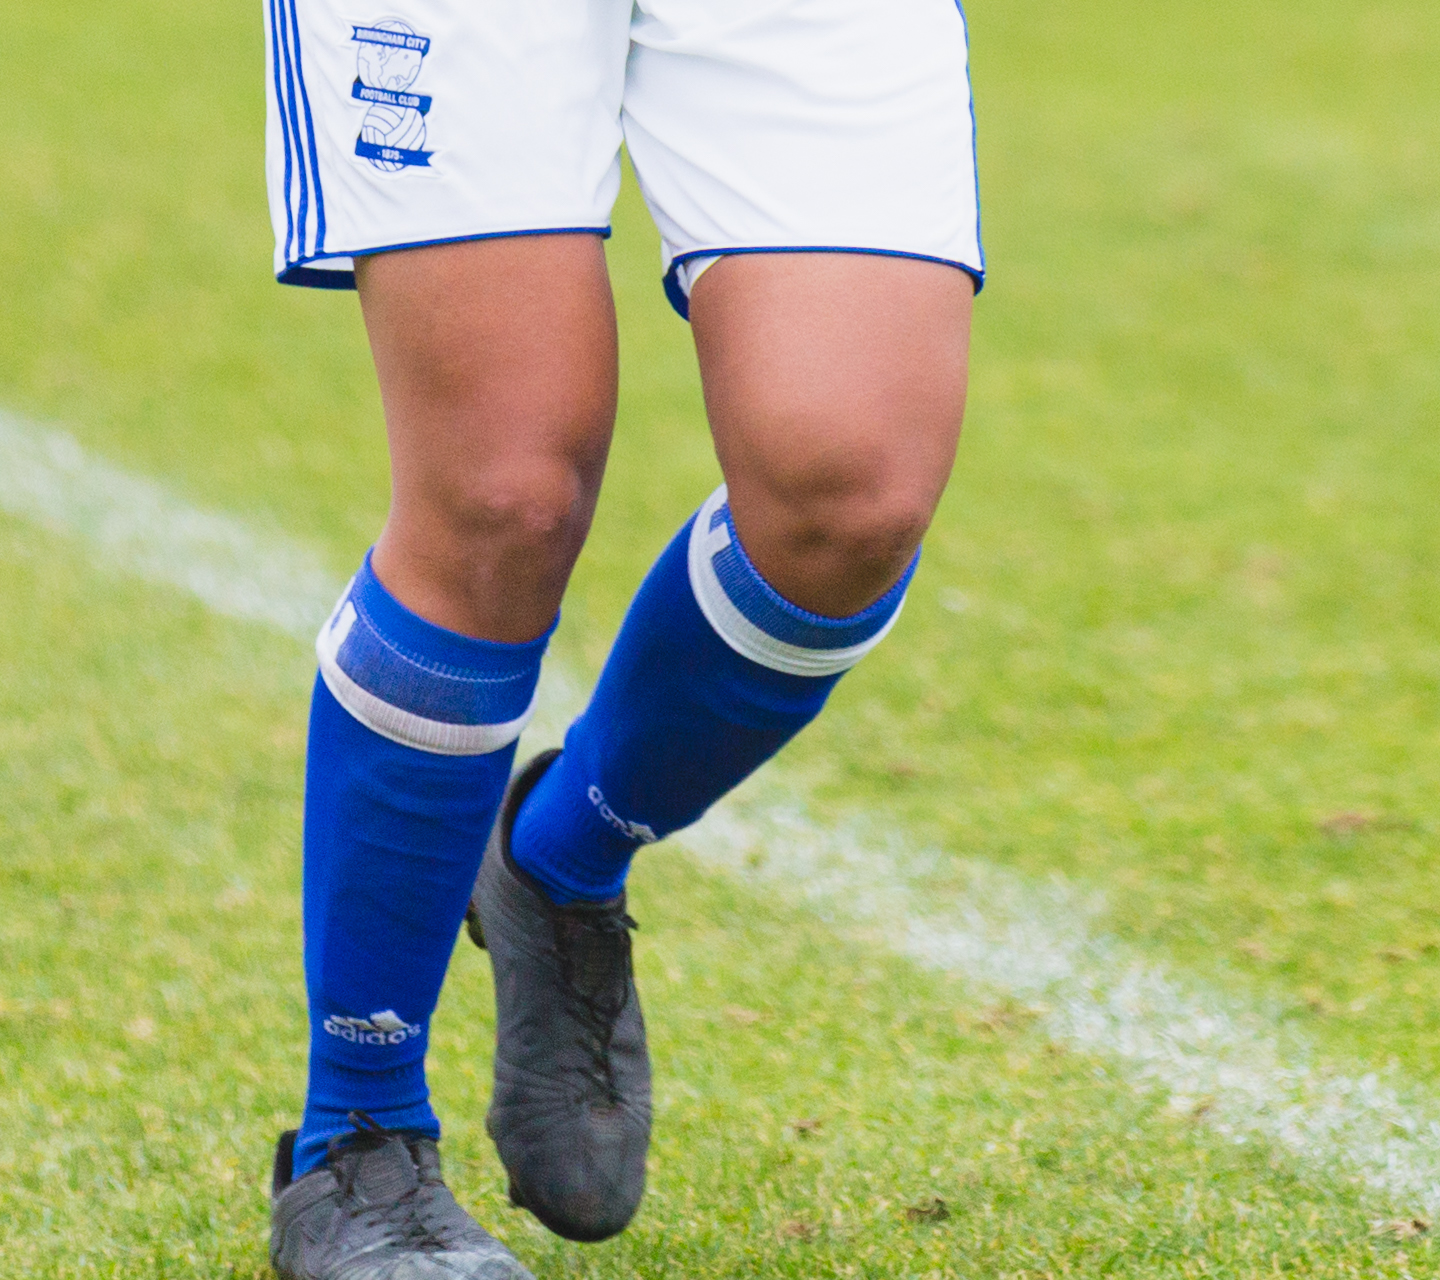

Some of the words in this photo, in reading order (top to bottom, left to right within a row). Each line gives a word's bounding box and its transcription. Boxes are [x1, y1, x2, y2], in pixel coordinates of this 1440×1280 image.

[356, 28, 405, 46] BIRMINGHAM
[406, 38, 427, 50] CITY
[360, 88, 397, 104] FOOTBALL
[398, 95, 420, 107] CLUB
[323, 1017, 422, 1046] adidas
